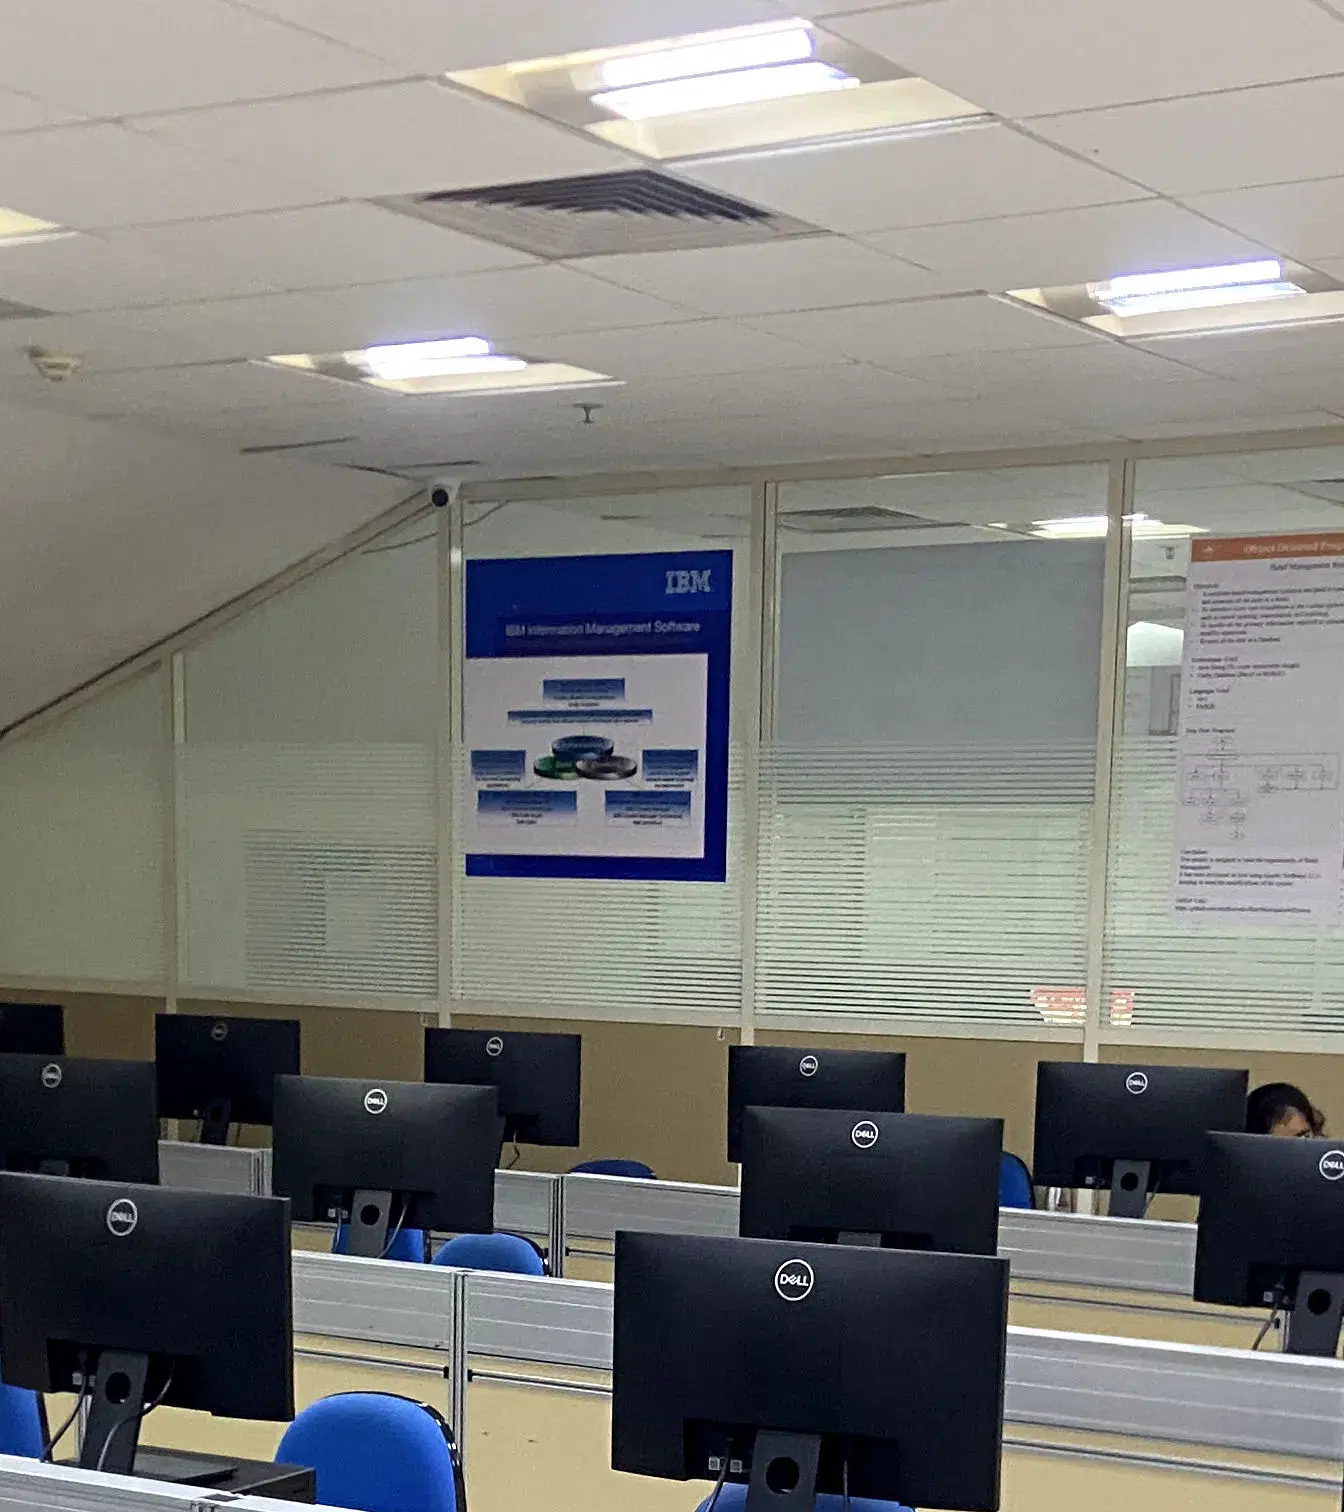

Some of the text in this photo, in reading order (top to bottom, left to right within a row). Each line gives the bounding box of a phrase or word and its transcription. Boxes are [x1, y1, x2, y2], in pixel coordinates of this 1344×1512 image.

[665, 569, 711, 594] IBM
[505, 620, 700, 637] IBM Information Management Software
